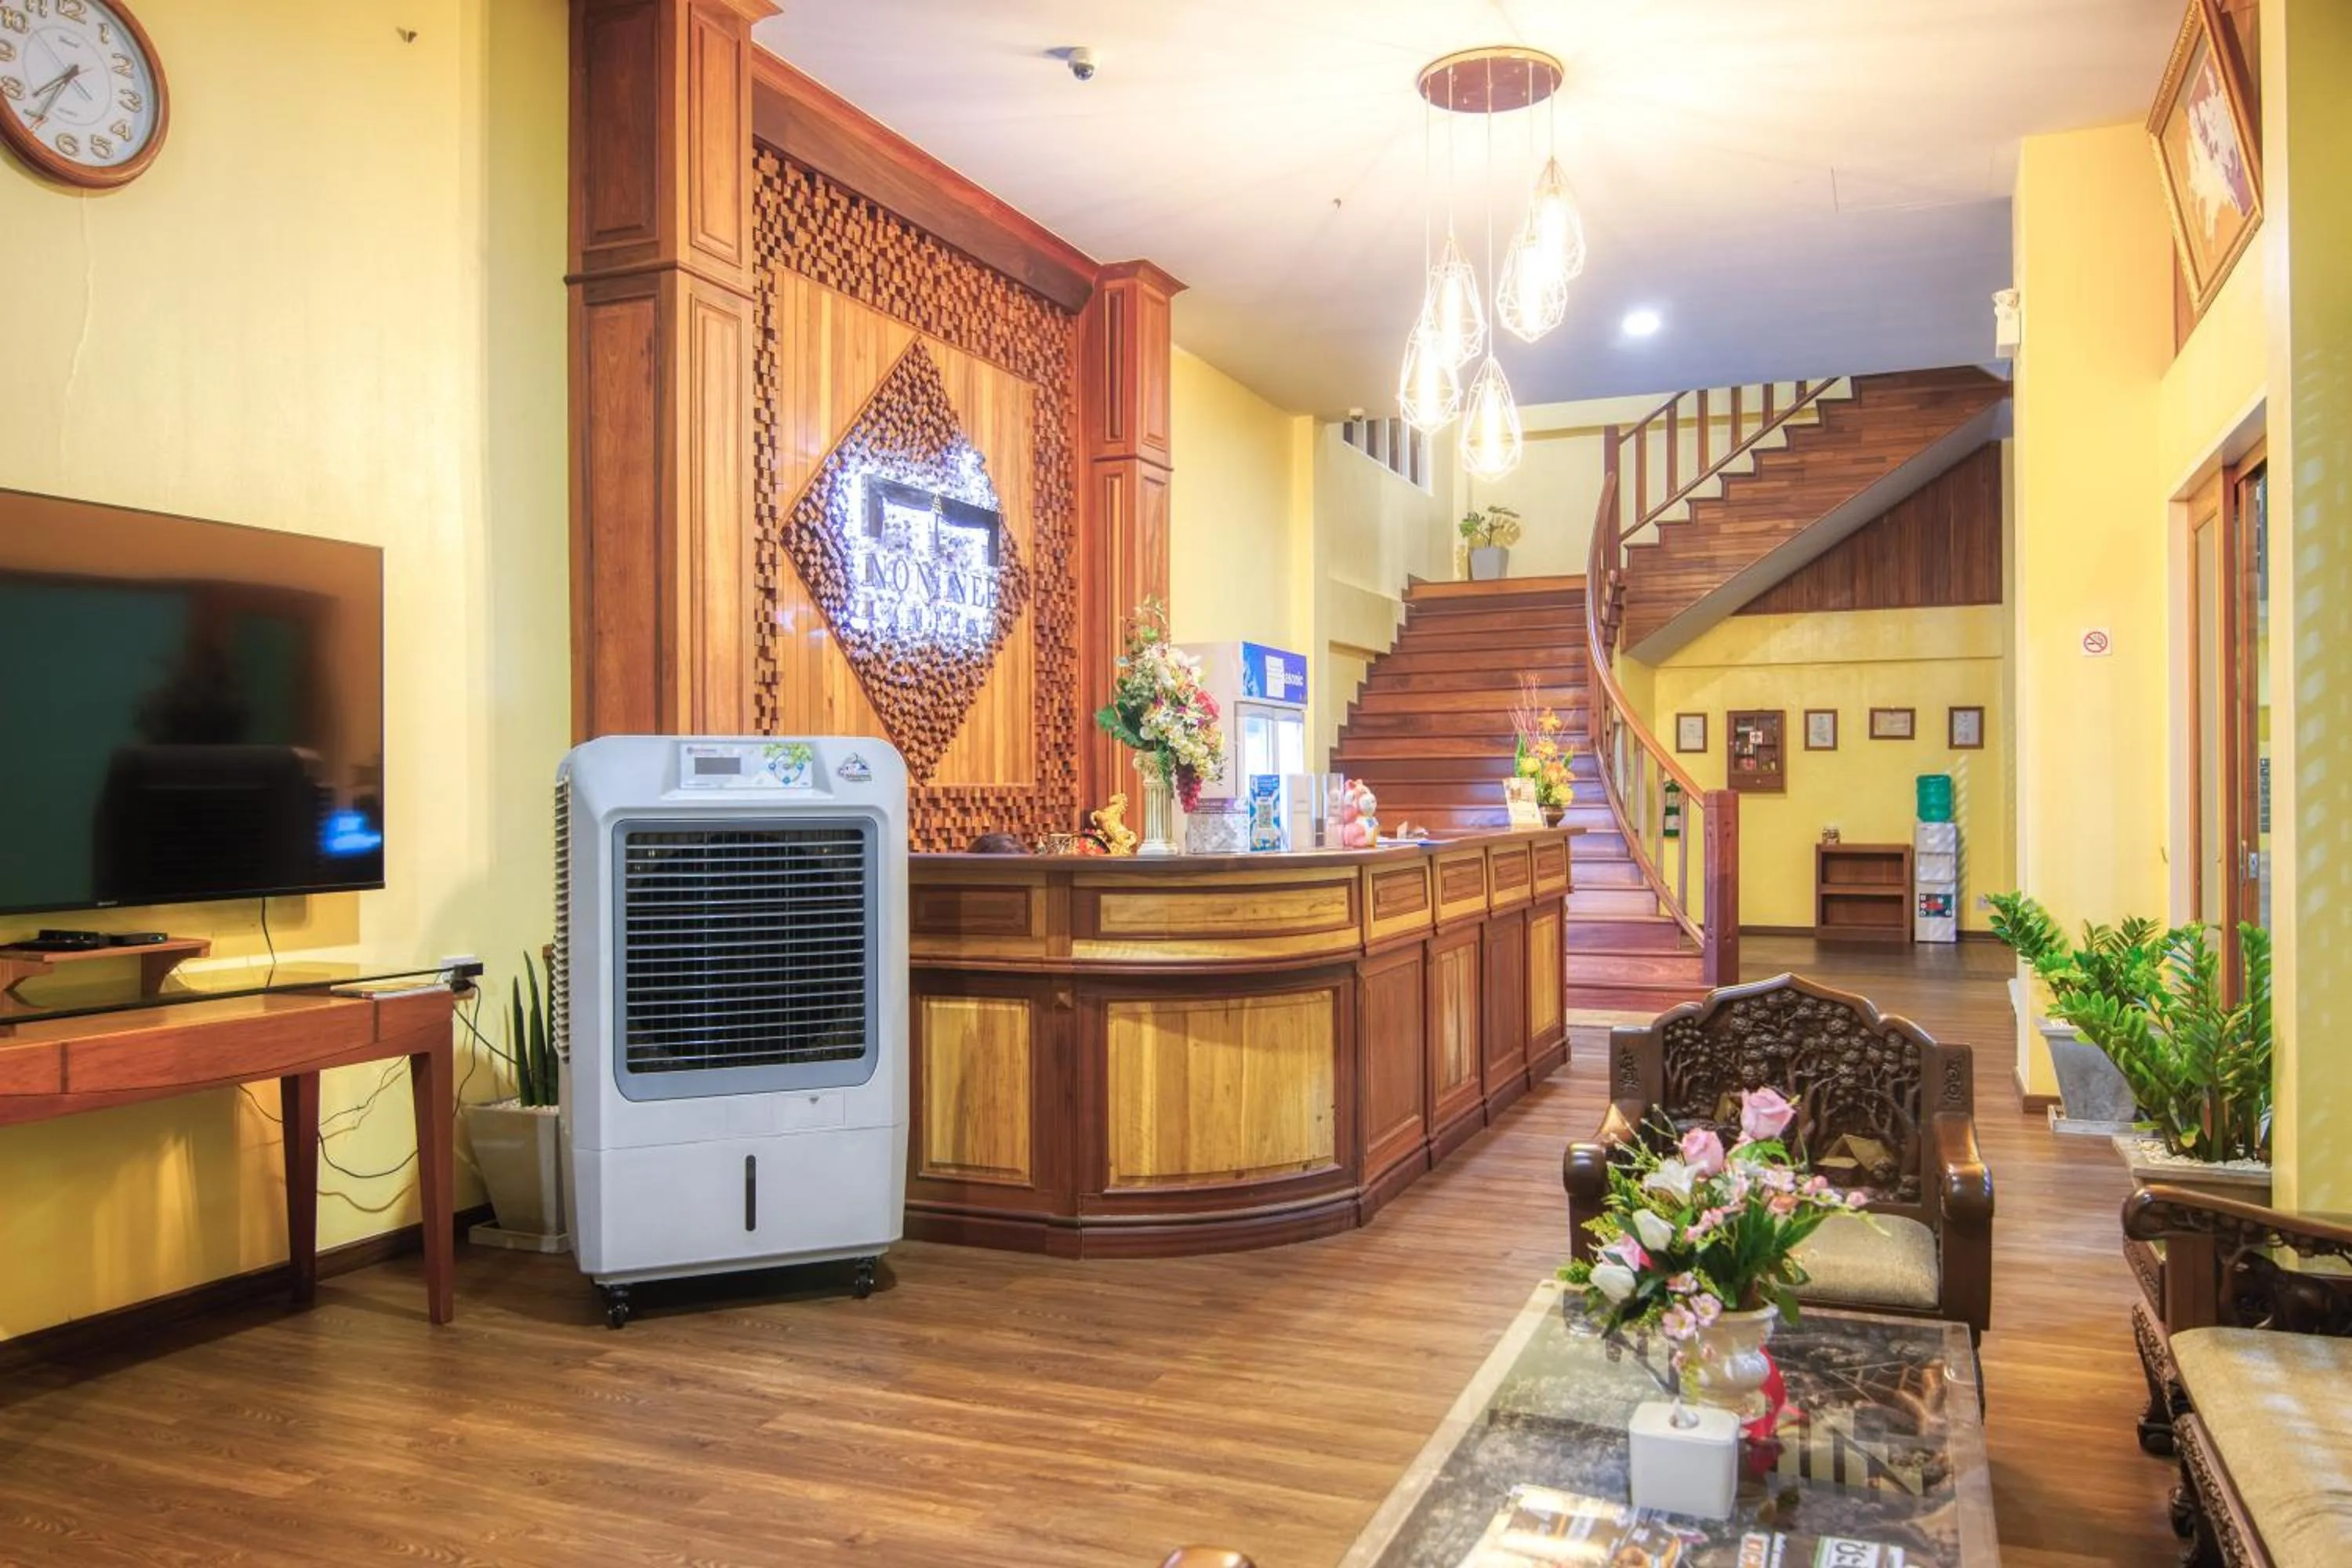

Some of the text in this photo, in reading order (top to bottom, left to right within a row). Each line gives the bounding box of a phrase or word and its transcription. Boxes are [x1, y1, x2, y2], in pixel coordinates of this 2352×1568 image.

[98, 22, 110, 45] 1
[111, 53, 135, 79] 2
[1, 75, 26, 100] 8
[119, 89, 143, 113] 3
[110, 118, 132, 142] 4
[55, 132, 80, 156] 6
[90, 134, 114, 159] 5
